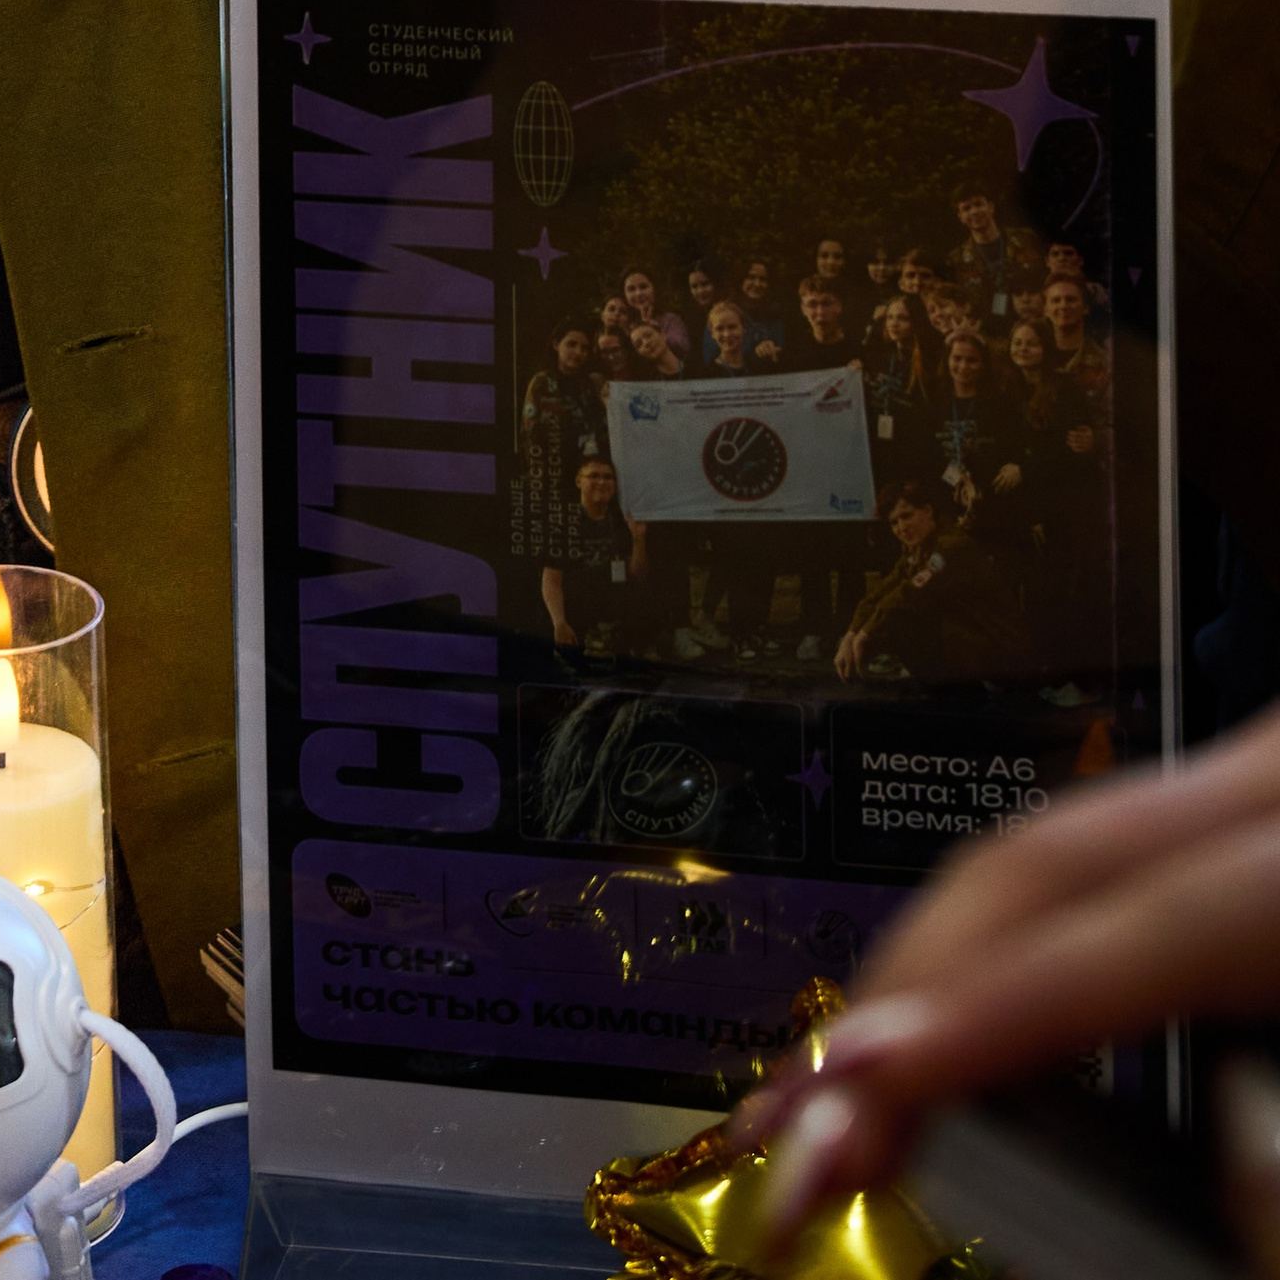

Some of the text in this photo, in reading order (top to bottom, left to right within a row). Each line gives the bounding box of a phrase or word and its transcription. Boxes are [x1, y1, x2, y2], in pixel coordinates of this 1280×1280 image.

[368, 22, 515, 43] СТУДЕНЧЕСКИЙ
[368, 42, 482, 60] СЕРВИСНЫЙ
[368, 61, 429, 78] ОТРЯД
[292, 84, 501, 835] СПУТНИК
[529, 444, 544, 556] ЧЕМ ПРОСТО
[567, 501, 582, 559] ОТРЯД
[861, 750, 1036, 782] место: А6
[624, 791, 712, 832] СПУТНИК
[860, 779, 1049, 813] дата: 18.10
[861, 806, 982, 835] время:
[322, 939, 475, 978] стань
[322, 981, 521, 1026] частью
